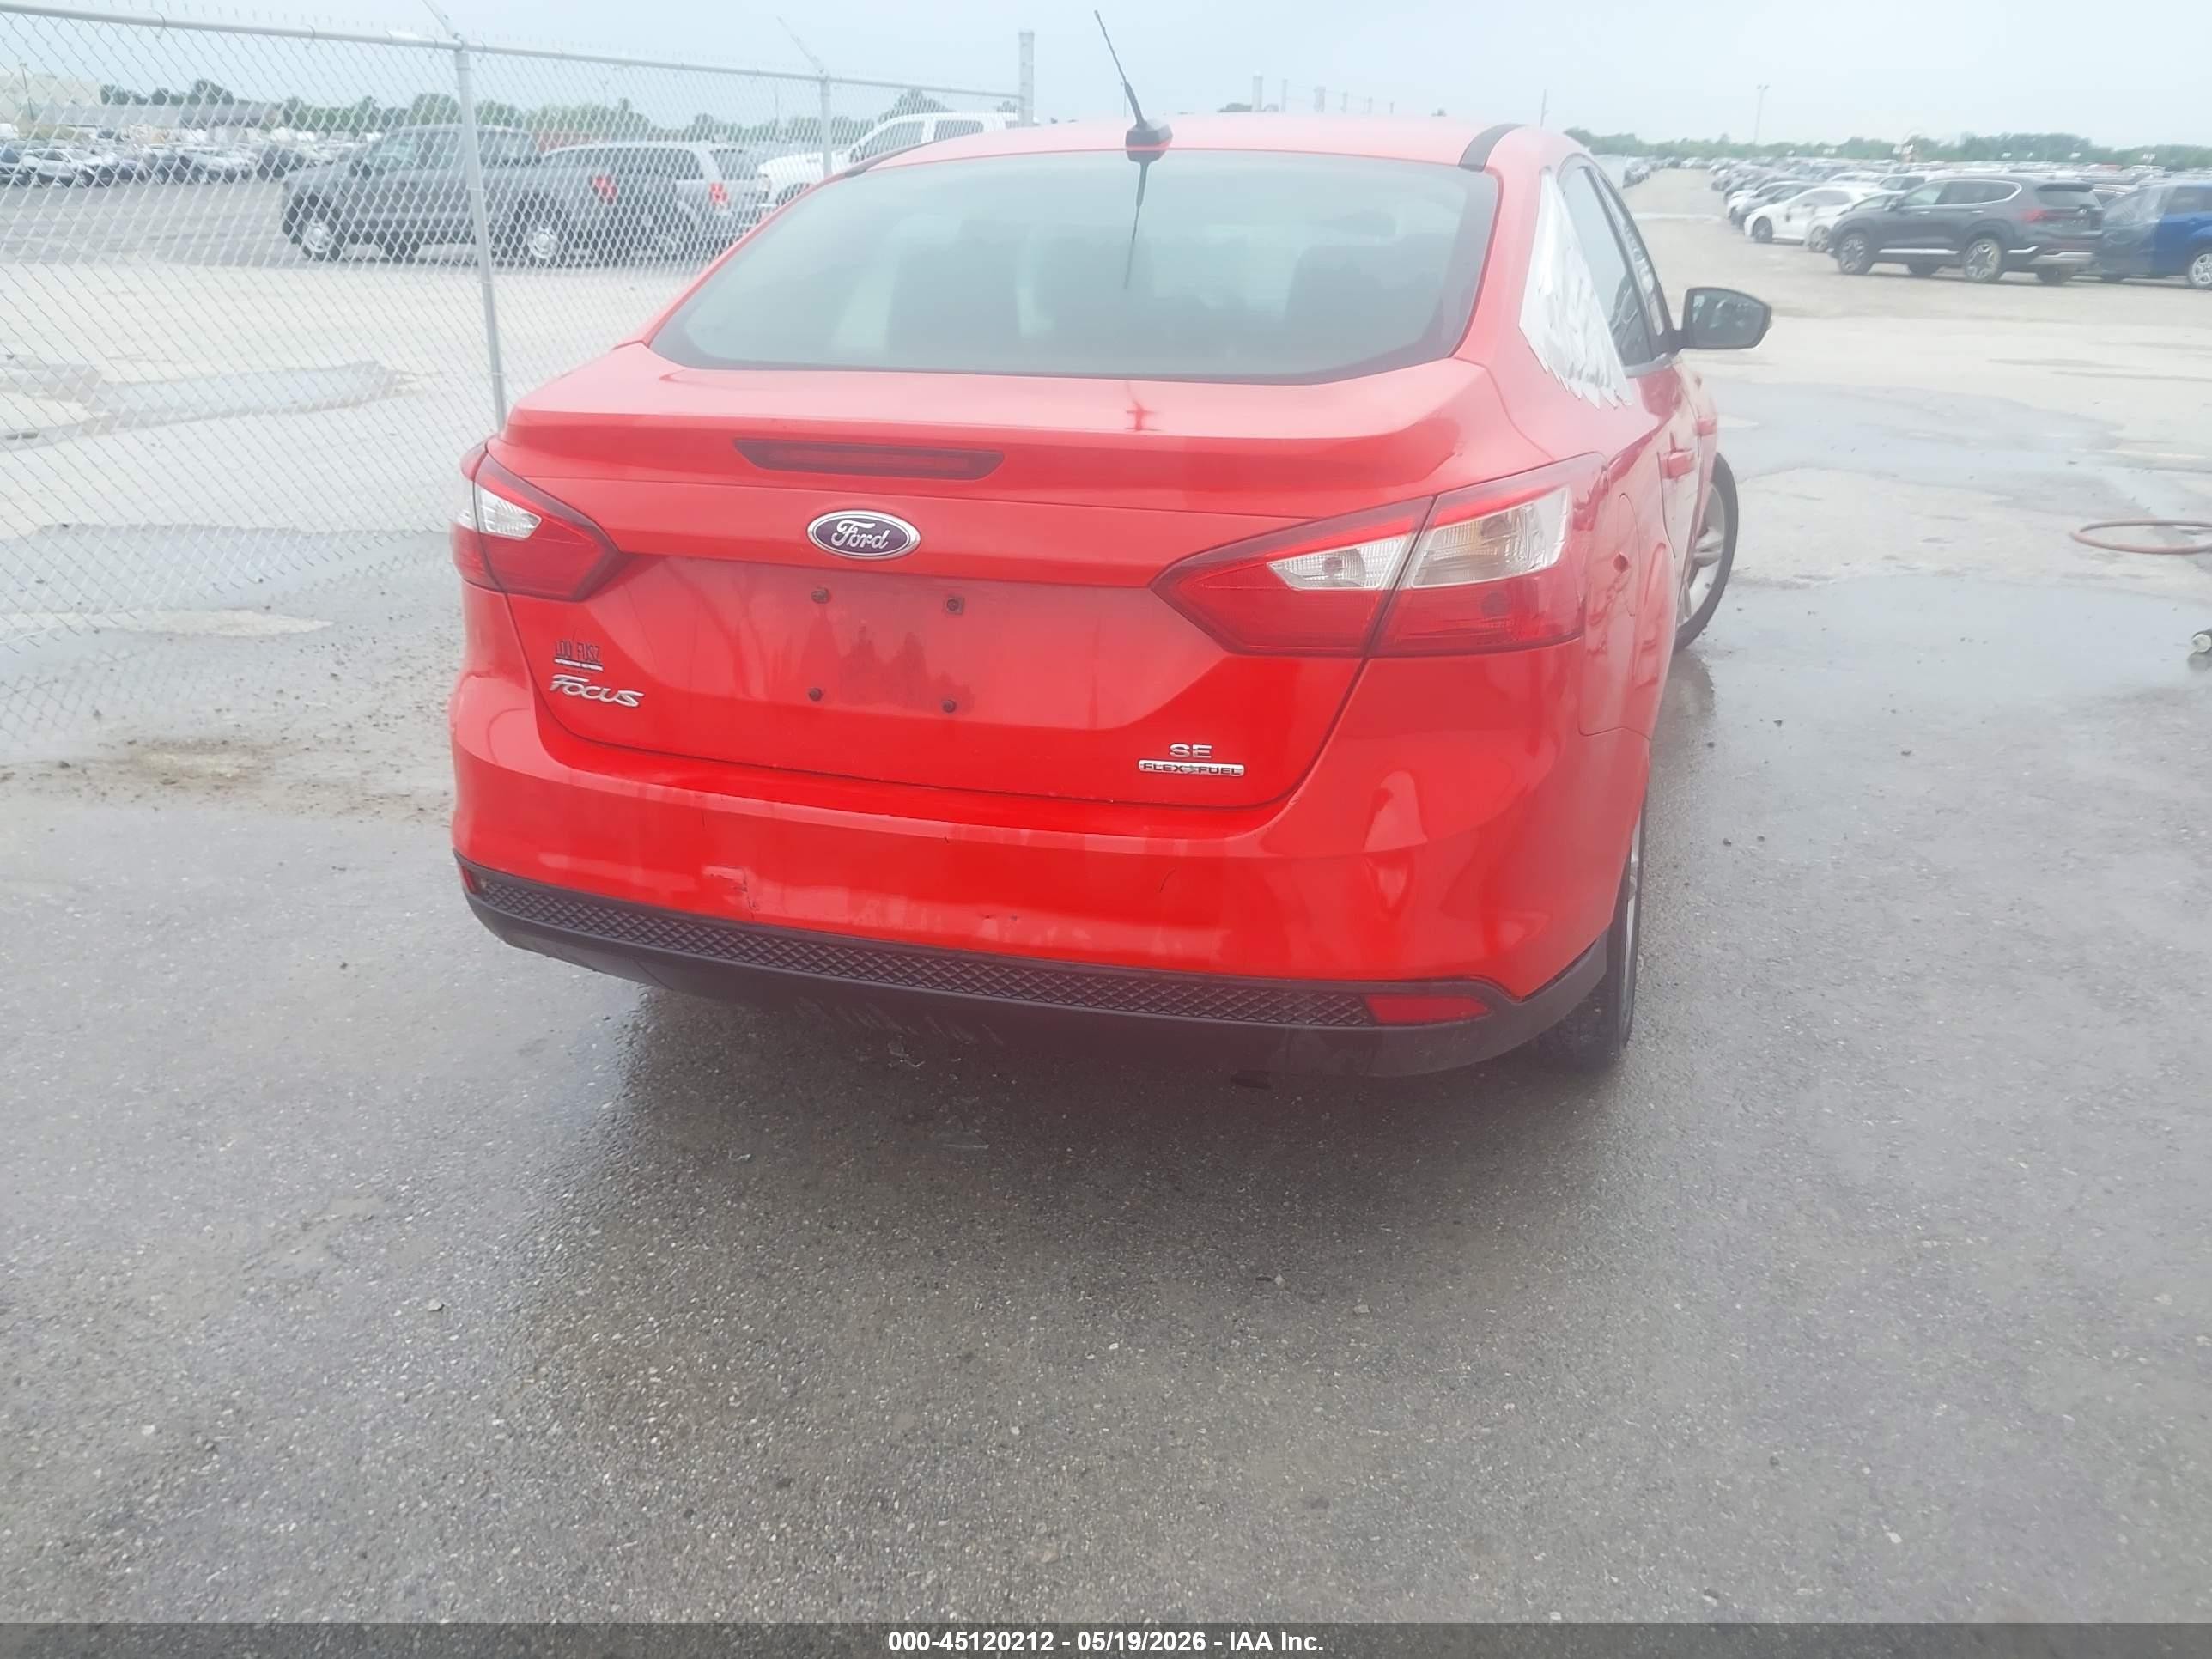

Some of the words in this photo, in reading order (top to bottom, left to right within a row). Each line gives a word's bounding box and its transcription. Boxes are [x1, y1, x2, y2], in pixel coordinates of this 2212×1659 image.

[830, 520, 890, 550] Ford
[550, 673, 645, 708] FOCUS
[1169, 743, 1212, 759] SE
[1143, 763, 1184, 773] FLEX
[1198, 766, 1243, 775] FUEL
